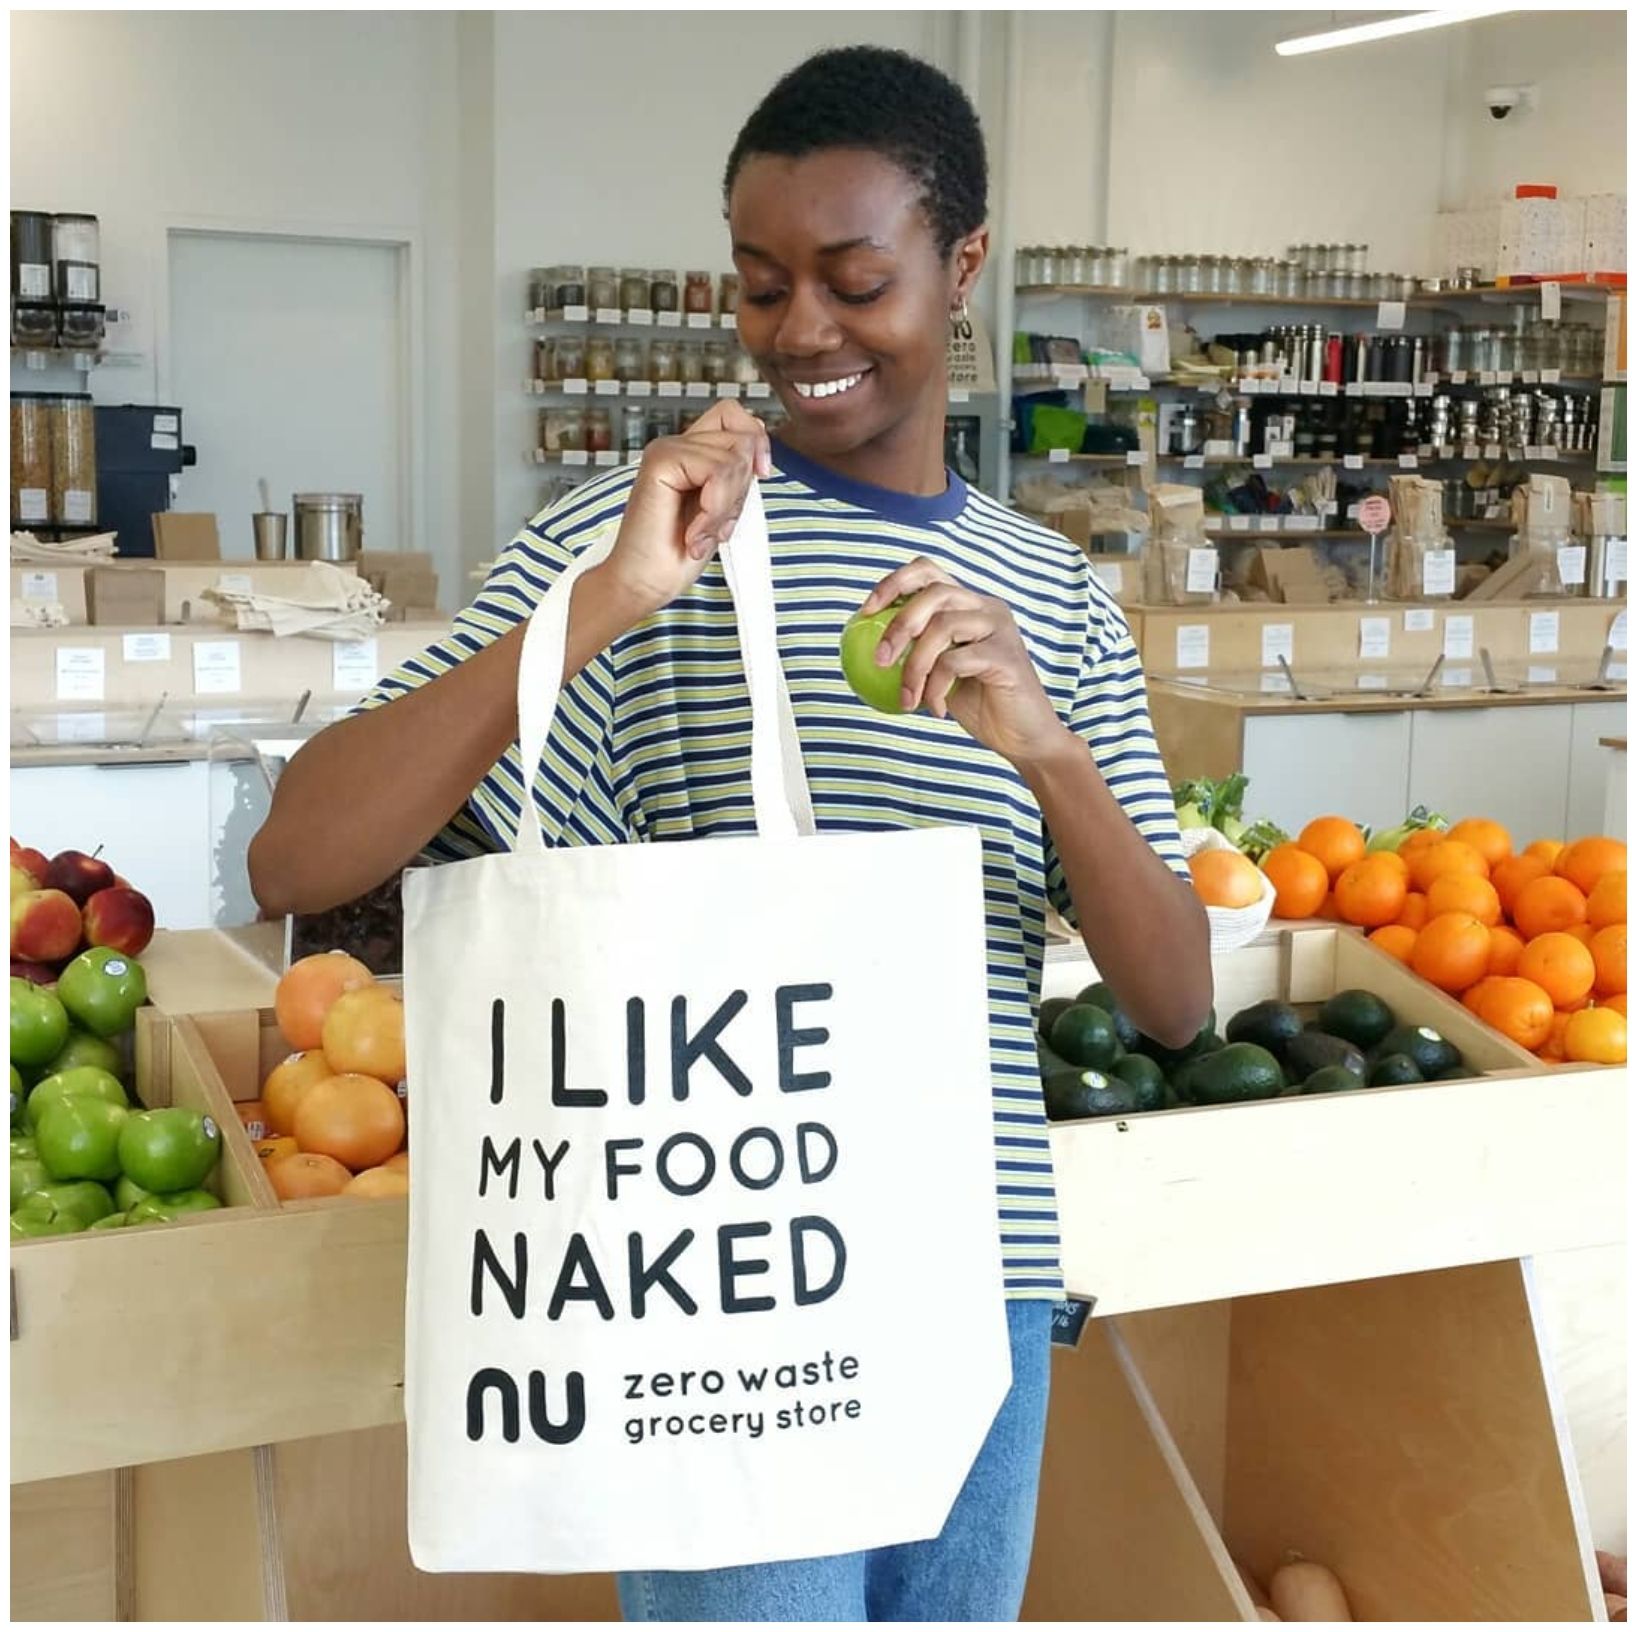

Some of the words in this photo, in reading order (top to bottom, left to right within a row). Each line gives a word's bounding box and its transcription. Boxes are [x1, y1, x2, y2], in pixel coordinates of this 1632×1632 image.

[490, 998, 505, 1105] I
[551, 982, 834, 1108] LIKE
[478, 1135, 570, 1200] MY
[605, 1121, 839, 1200] FOOD
[470, 1215, 847, 1321] NAKED
[466, 1367, 586, 1445] nu
[624, 1370, 724, 1399] zero
[737, 1350, 860, 1392] waste
[624, 1408, 765, 1444] grocery
[776, 1398, 862, 1430] store
